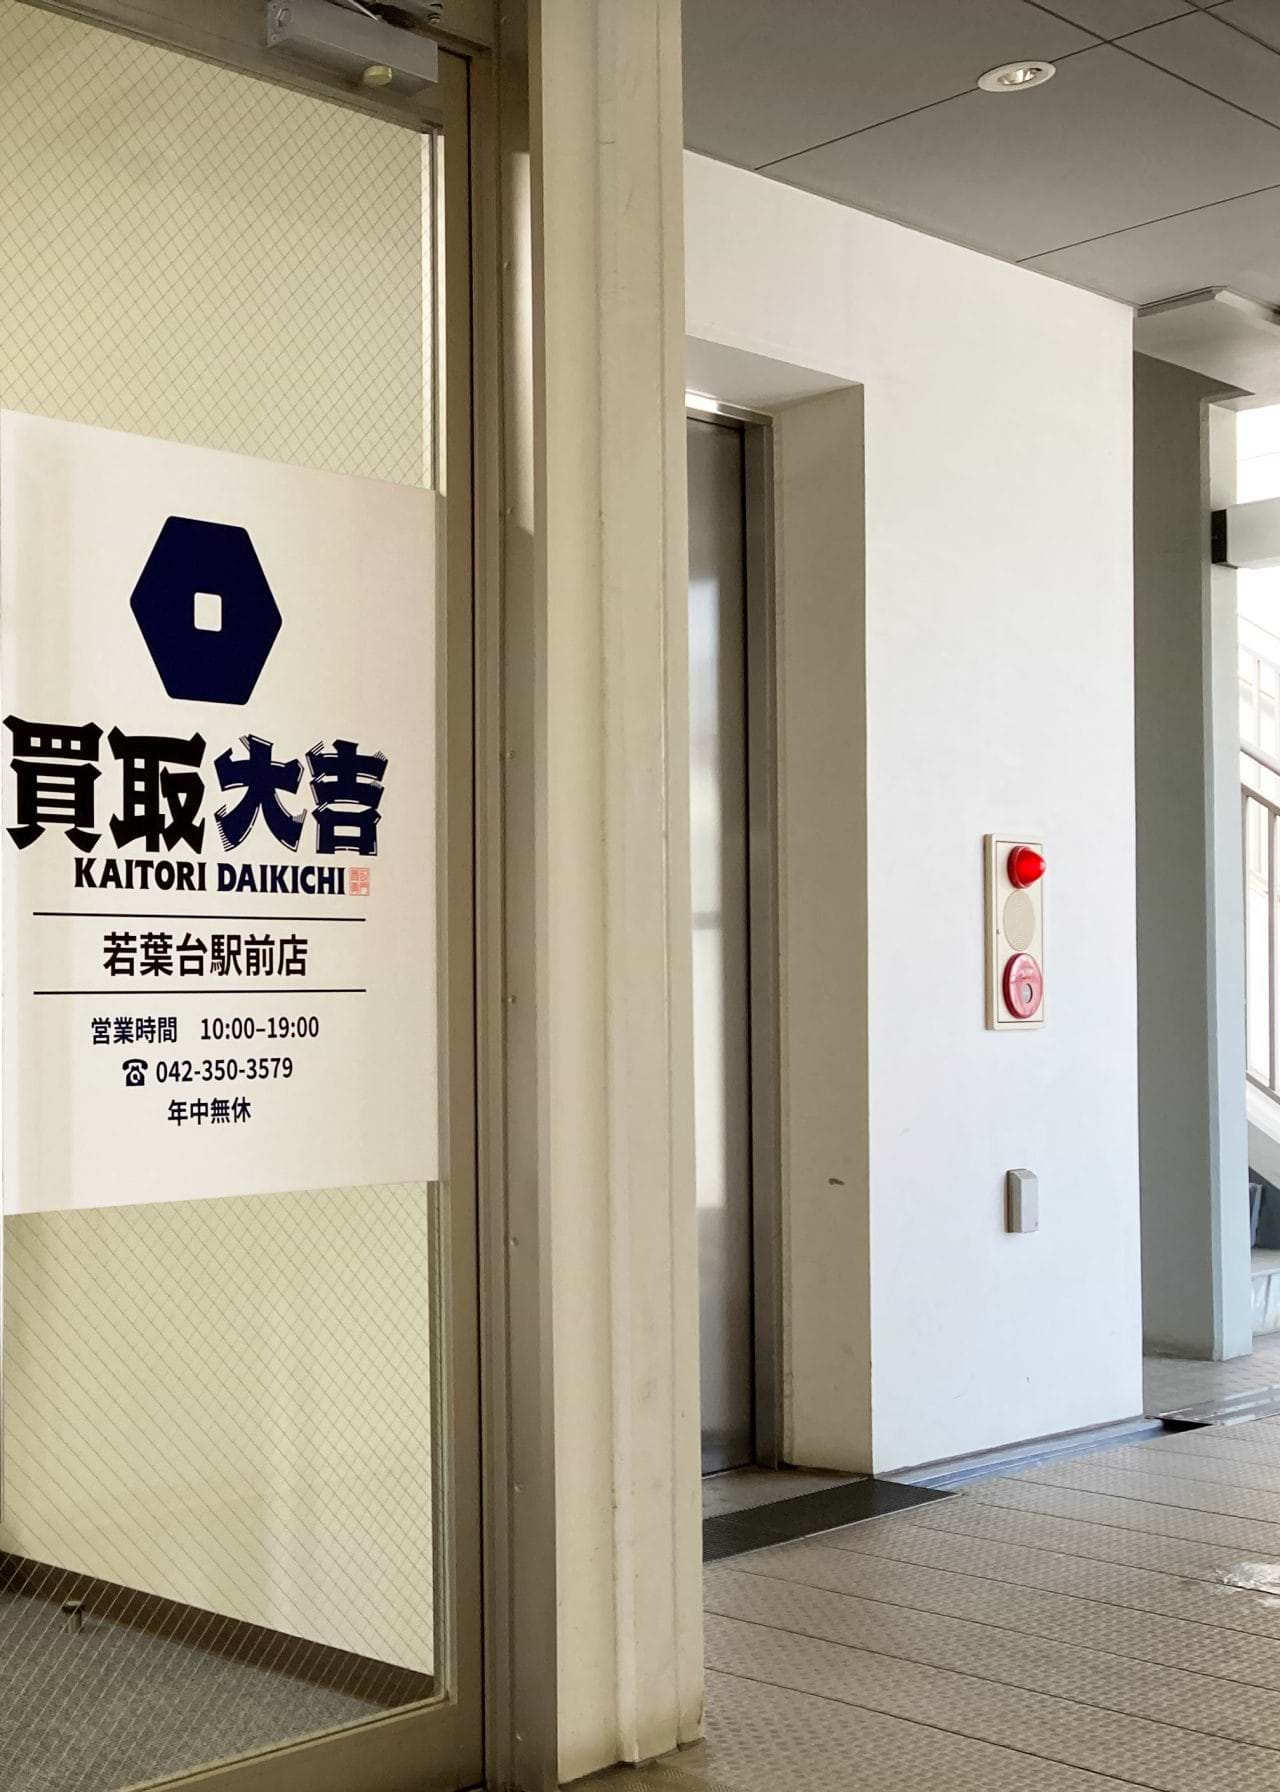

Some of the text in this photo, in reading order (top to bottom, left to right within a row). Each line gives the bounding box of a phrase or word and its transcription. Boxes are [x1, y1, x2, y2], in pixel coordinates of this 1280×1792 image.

[2, 715, 389, 857] 買取大吉
[74, 858, 207, 892] KAITORI
[216, 863, 346, 895] DAIKICHI
[103, 931, 308, 977] 若葉台駅前店
[91, 1016, 178, 1045] 営業時間
[156, 1057, 293, 1083] 042-350-3579
[167, 1096, 251, 1127] 年中無休
